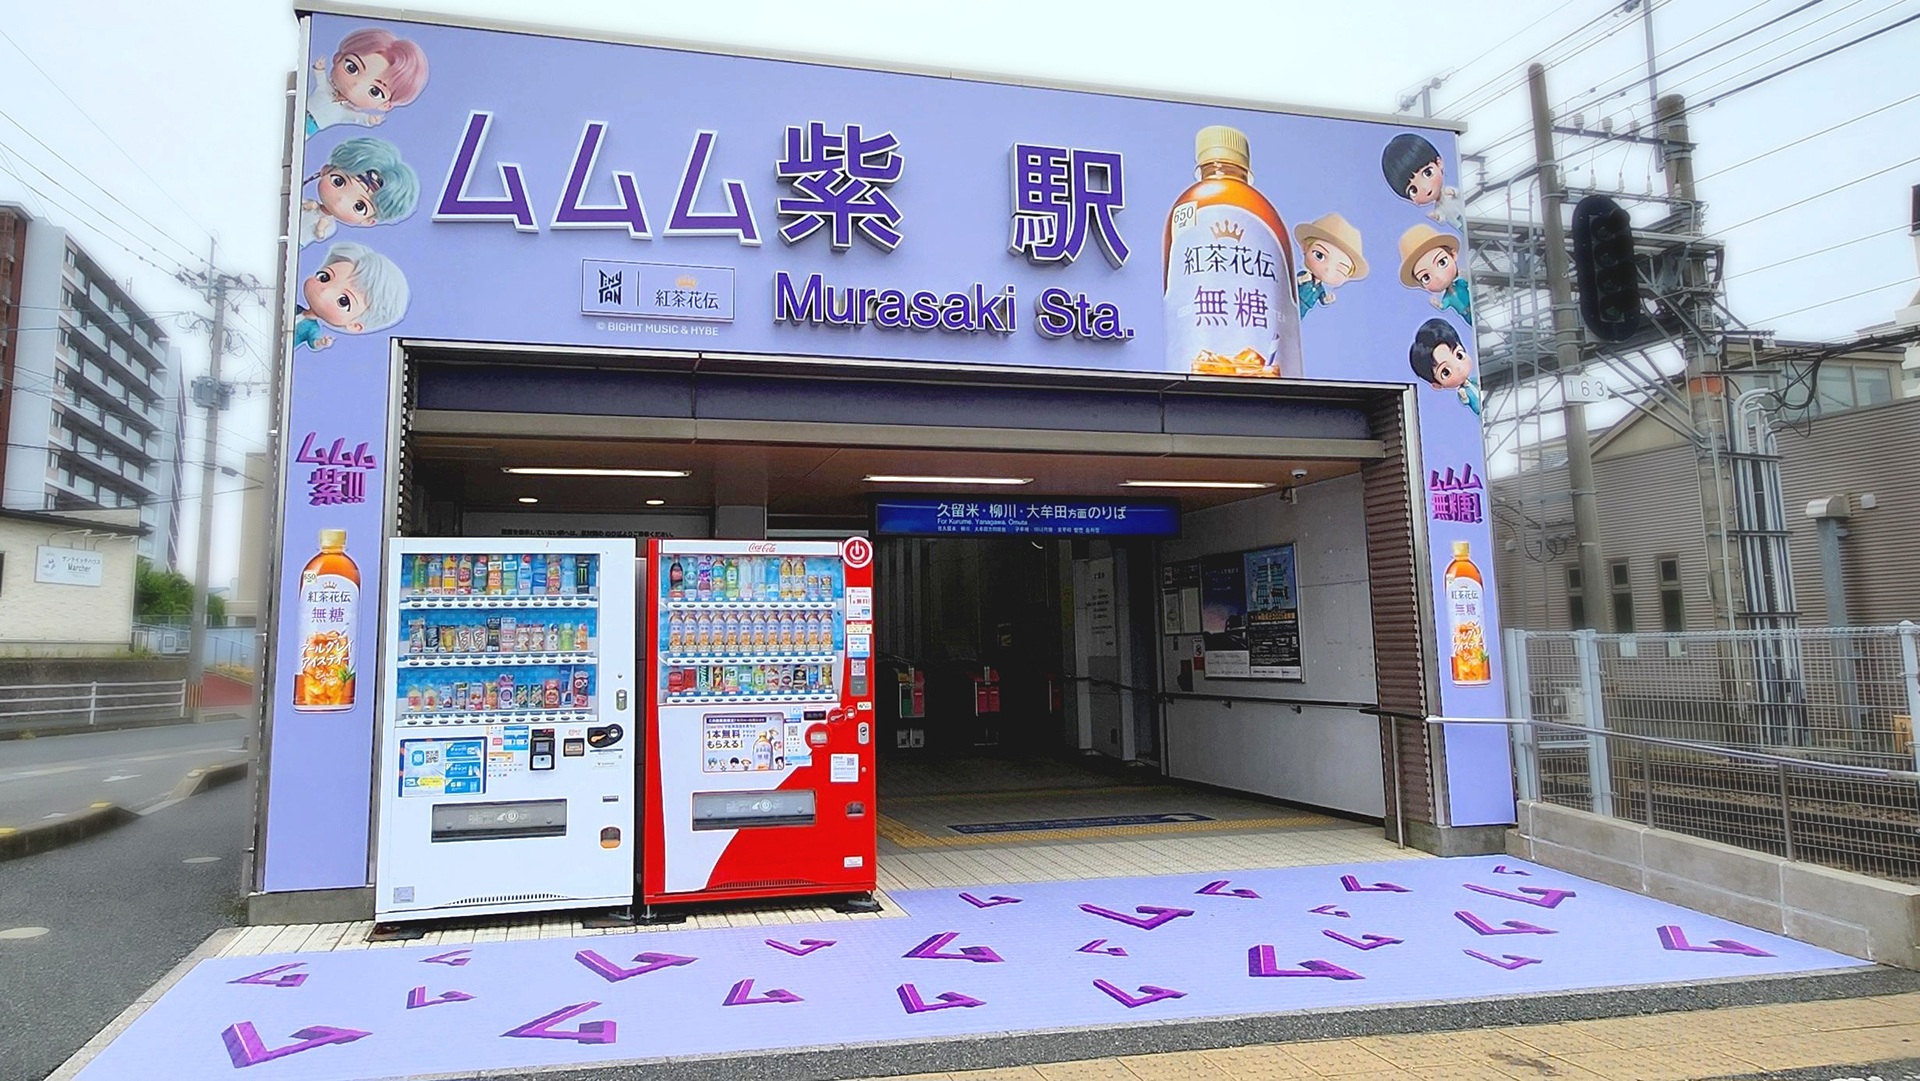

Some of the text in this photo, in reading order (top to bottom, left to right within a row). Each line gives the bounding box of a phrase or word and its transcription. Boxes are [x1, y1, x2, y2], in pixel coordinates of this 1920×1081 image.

[1007, 141, 1131, 268] 駅
[1174, 205, 1194, 224] 650
[1184, 243, 1277, 281] 紅茶花伝
[655, 289, 719, 310] 紅茶花伝
[773, 270, 1136, 342] Murasaki Sta.
[1194, 285, 1269, 330] 無糖
[607, 321, 644, 333] BIGHIT
[645, 324, 679, 334] MUSIC
[680, 326, 688, 335] &
[690, 326, 719, 336] HYBE
[1569, 380, 1605, 397] 163
[295, 431, 378, 469] ムムム
[1429, 462, 1483, 491] ムムム
[1431, 491, 1483, 524] 無糖!
[307, 590, 351, 603] 紅茶花伝
[311, 606, 345, 623] 無糖
[1455, 603, 1477, 616] 無糖
[706, 729, 741, 739] 1本無料
[707, 739, 744, 749] もらえる!
